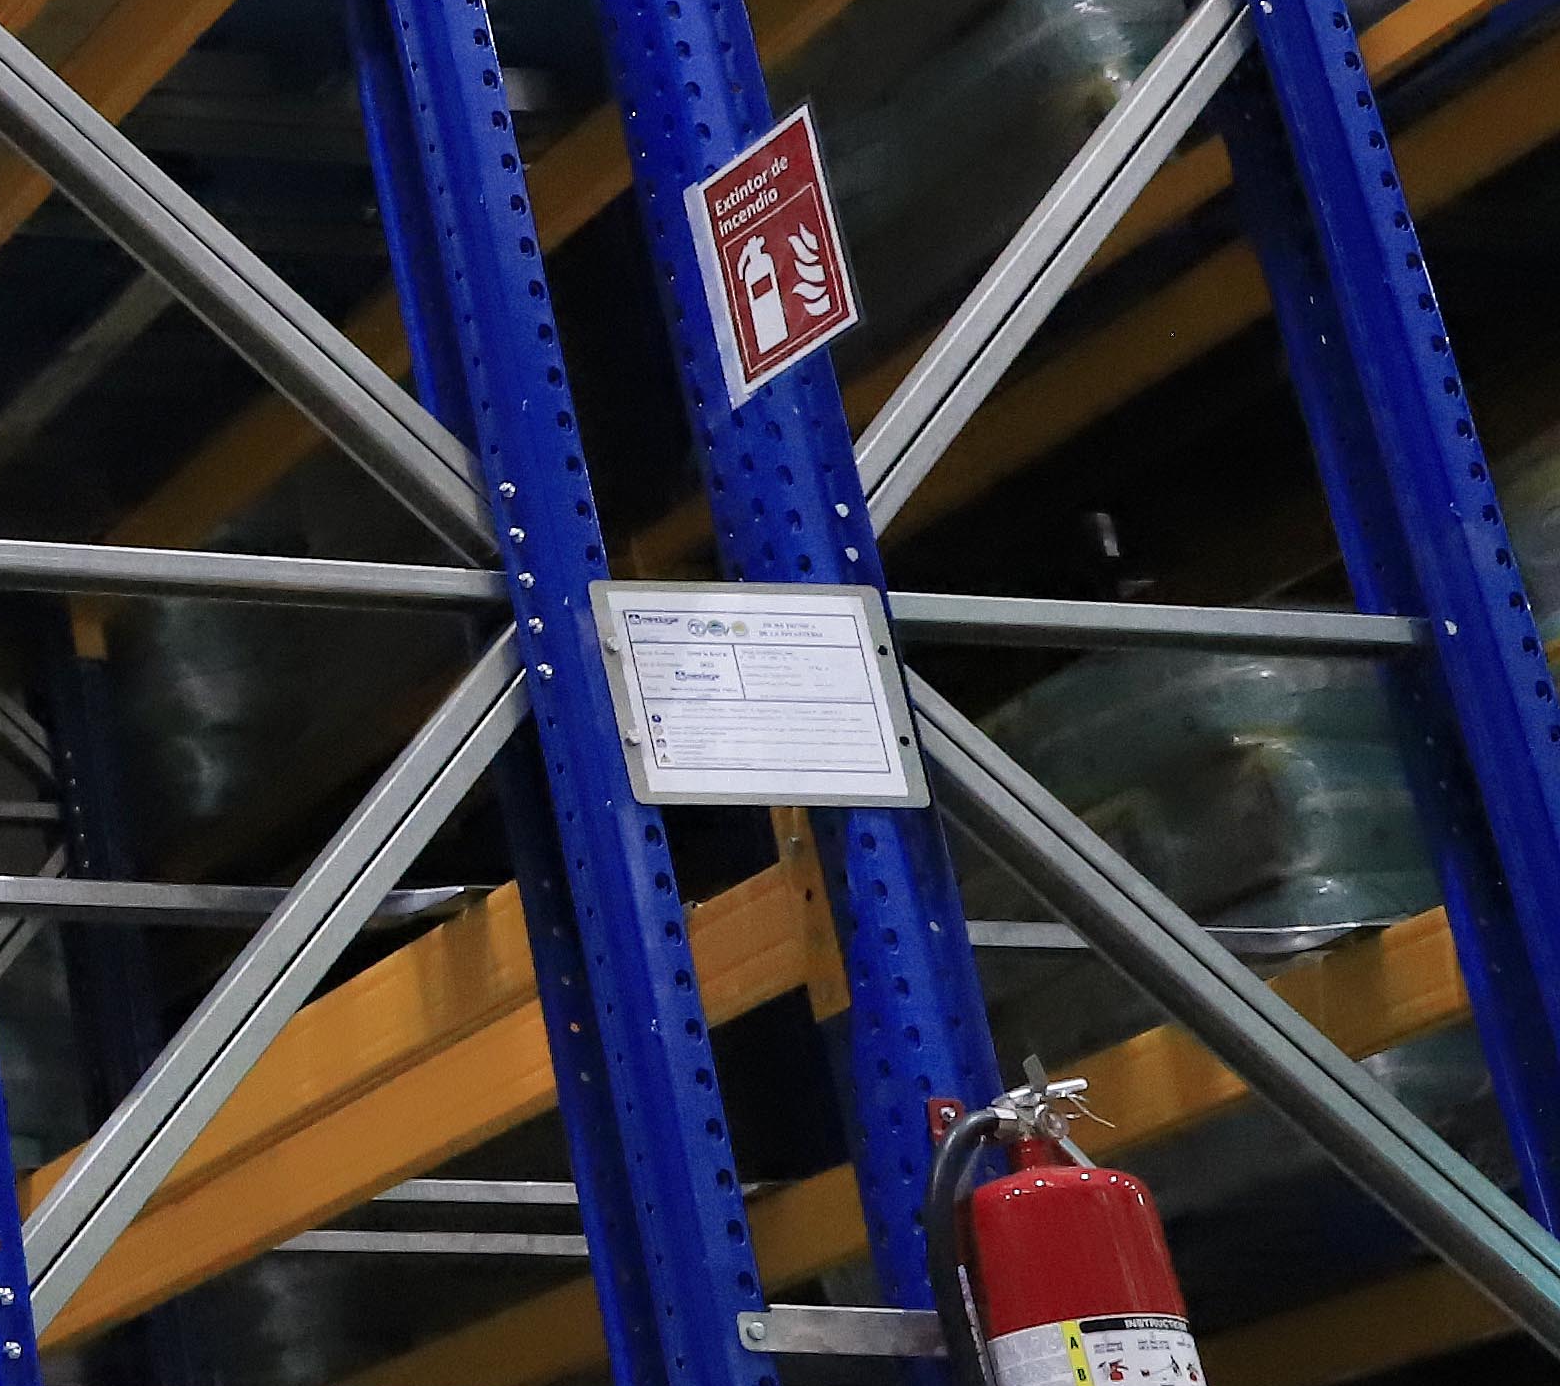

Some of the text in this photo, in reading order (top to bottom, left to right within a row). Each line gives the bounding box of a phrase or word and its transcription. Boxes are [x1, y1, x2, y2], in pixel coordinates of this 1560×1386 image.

[715, 156, 788, 217] Extintor de
[718, 188, 779, 238] incendio
[1070, 1336, 1078, 1350] A
